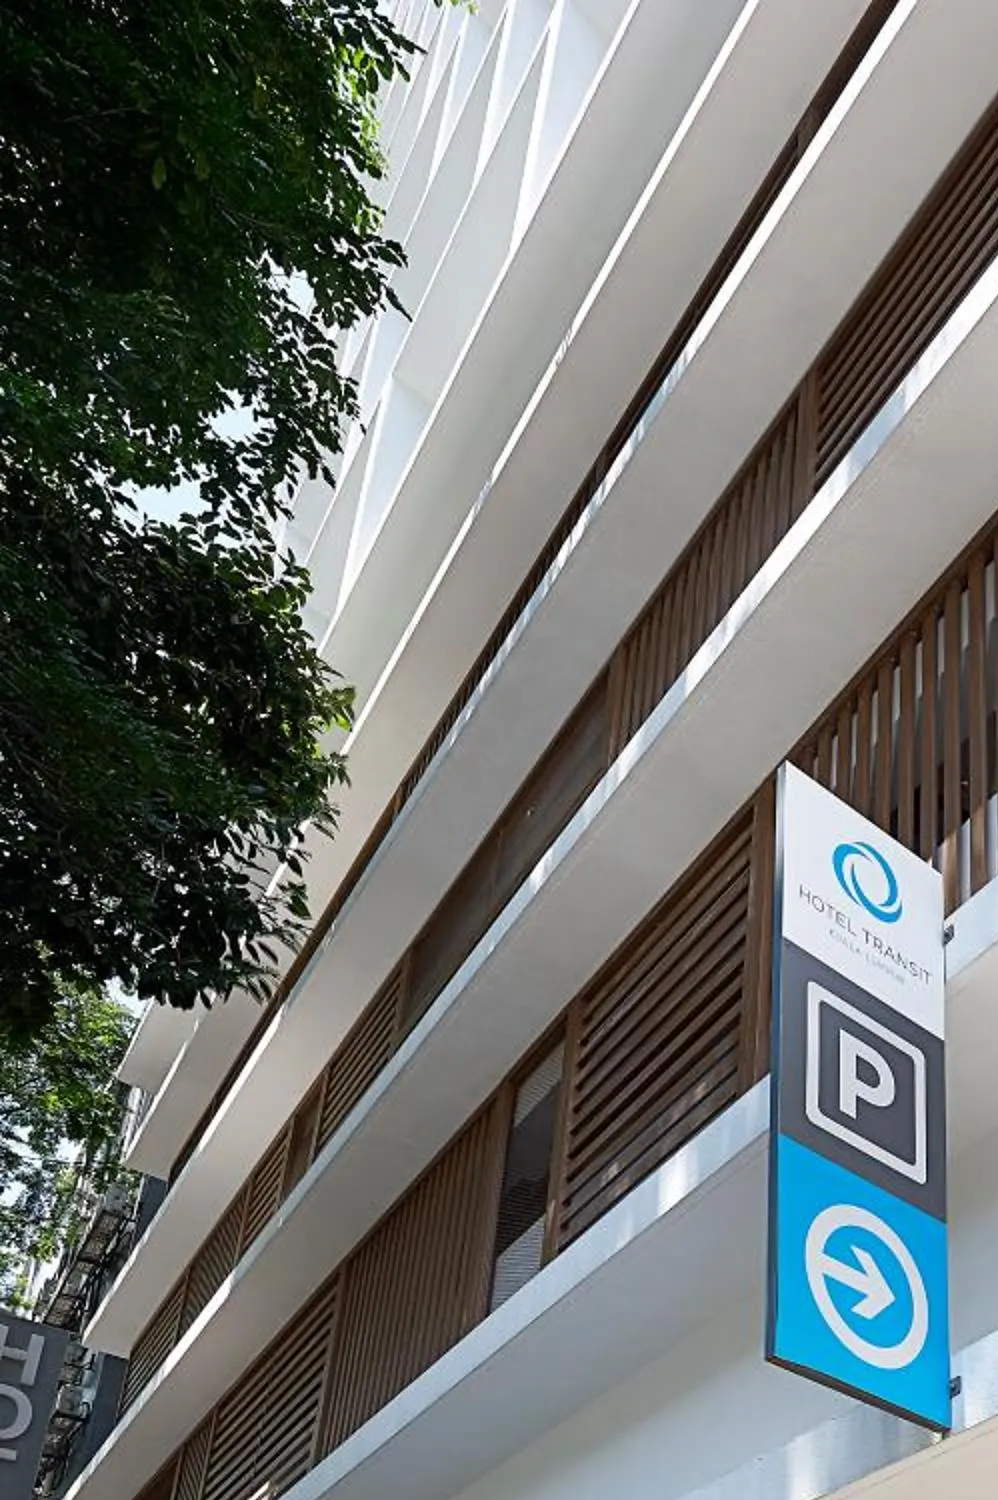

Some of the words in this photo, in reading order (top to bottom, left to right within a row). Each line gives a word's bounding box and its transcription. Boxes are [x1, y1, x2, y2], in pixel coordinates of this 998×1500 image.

[799, 884, 857, 936] HOTEL
[862, 928, 933, 985] TRANSIT
[839, 1028, 895, 1120] P
